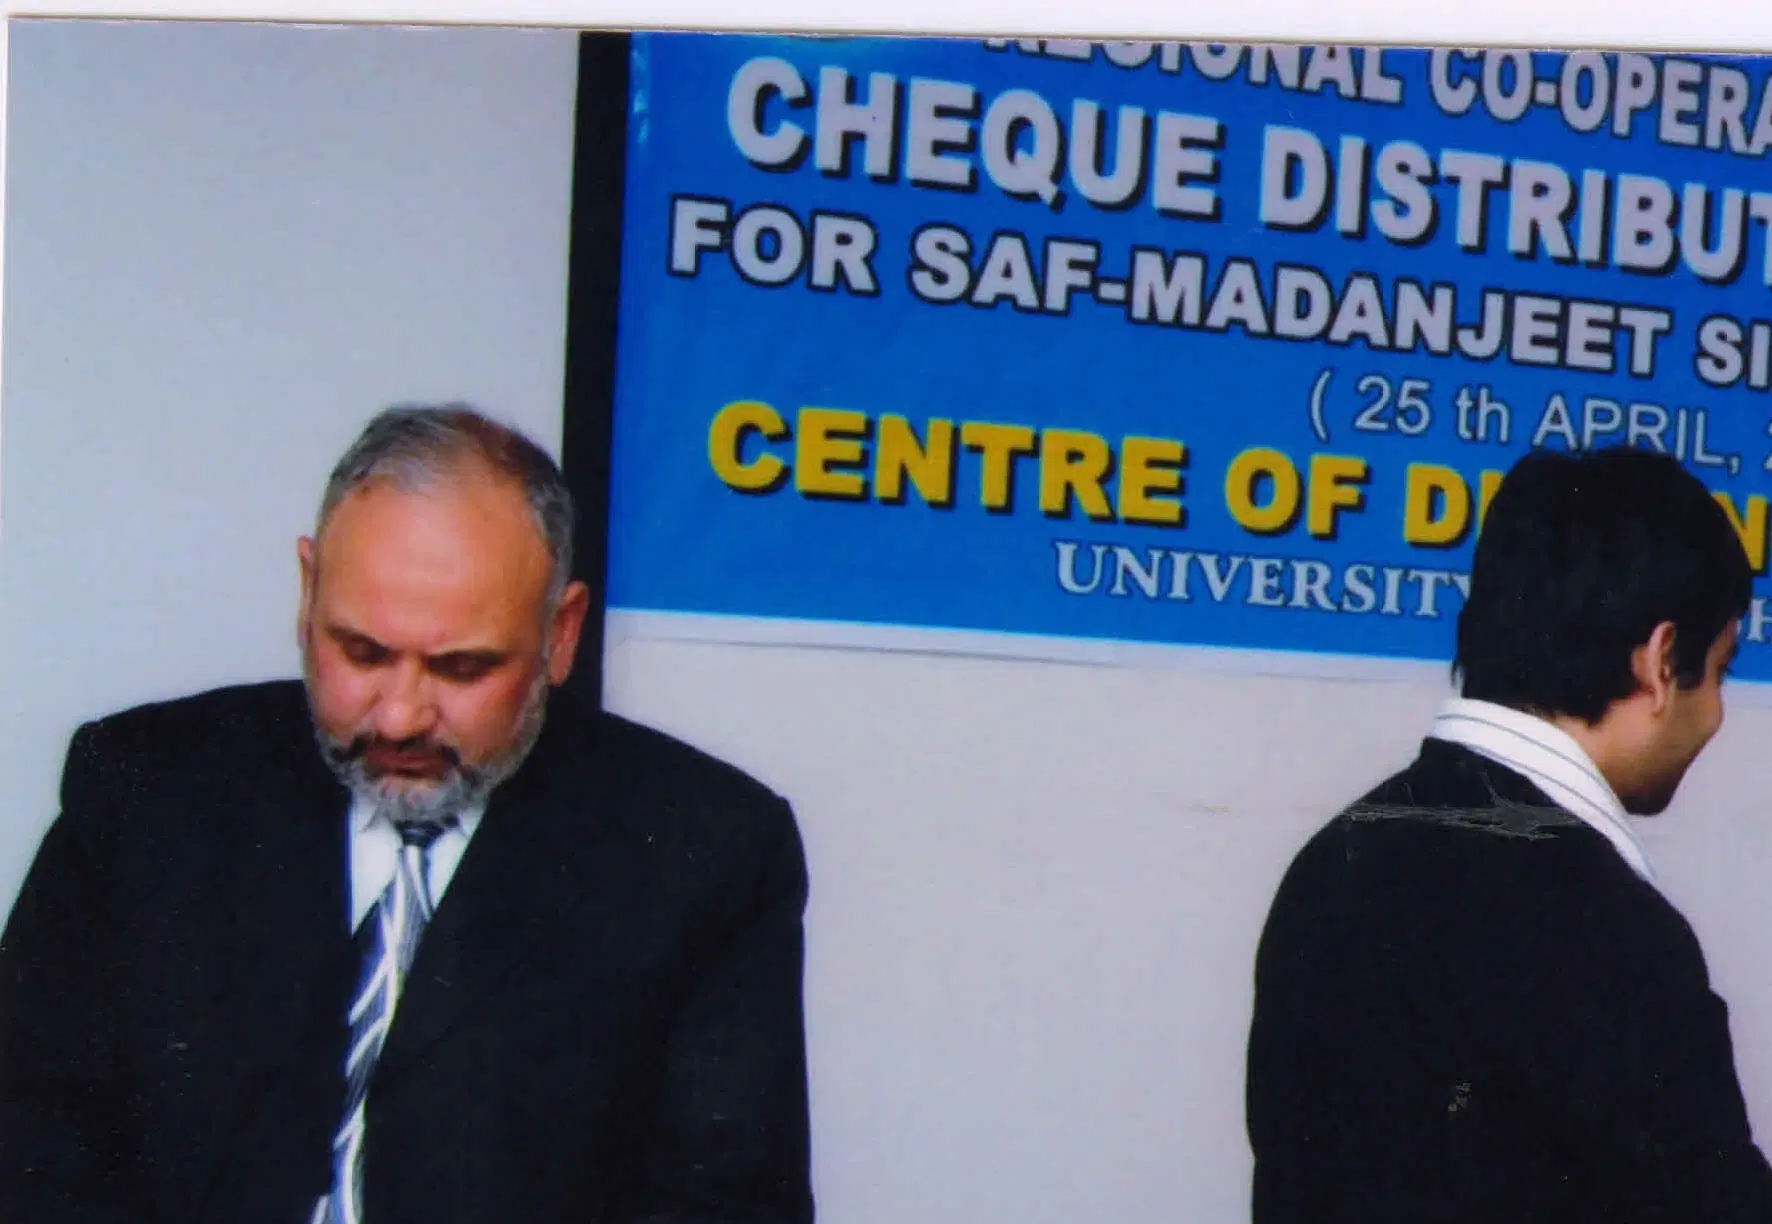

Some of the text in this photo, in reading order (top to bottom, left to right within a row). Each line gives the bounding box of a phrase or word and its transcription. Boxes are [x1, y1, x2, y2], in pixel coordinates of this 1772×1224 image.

[728, 58, 1219, 215] CHEQUE
[672, 200, 874, 290] FOR
[912, 228, 1670, 374] SAF-MADANJEET
[708, 401, 1185, 522] CENTRE
[1225, 448, 1366, 535] OF
[1355, 376, 1430, 434] 25
[1456, 388, 1508, 442] th
[1532, 393, 1741, 474] APRIL,
